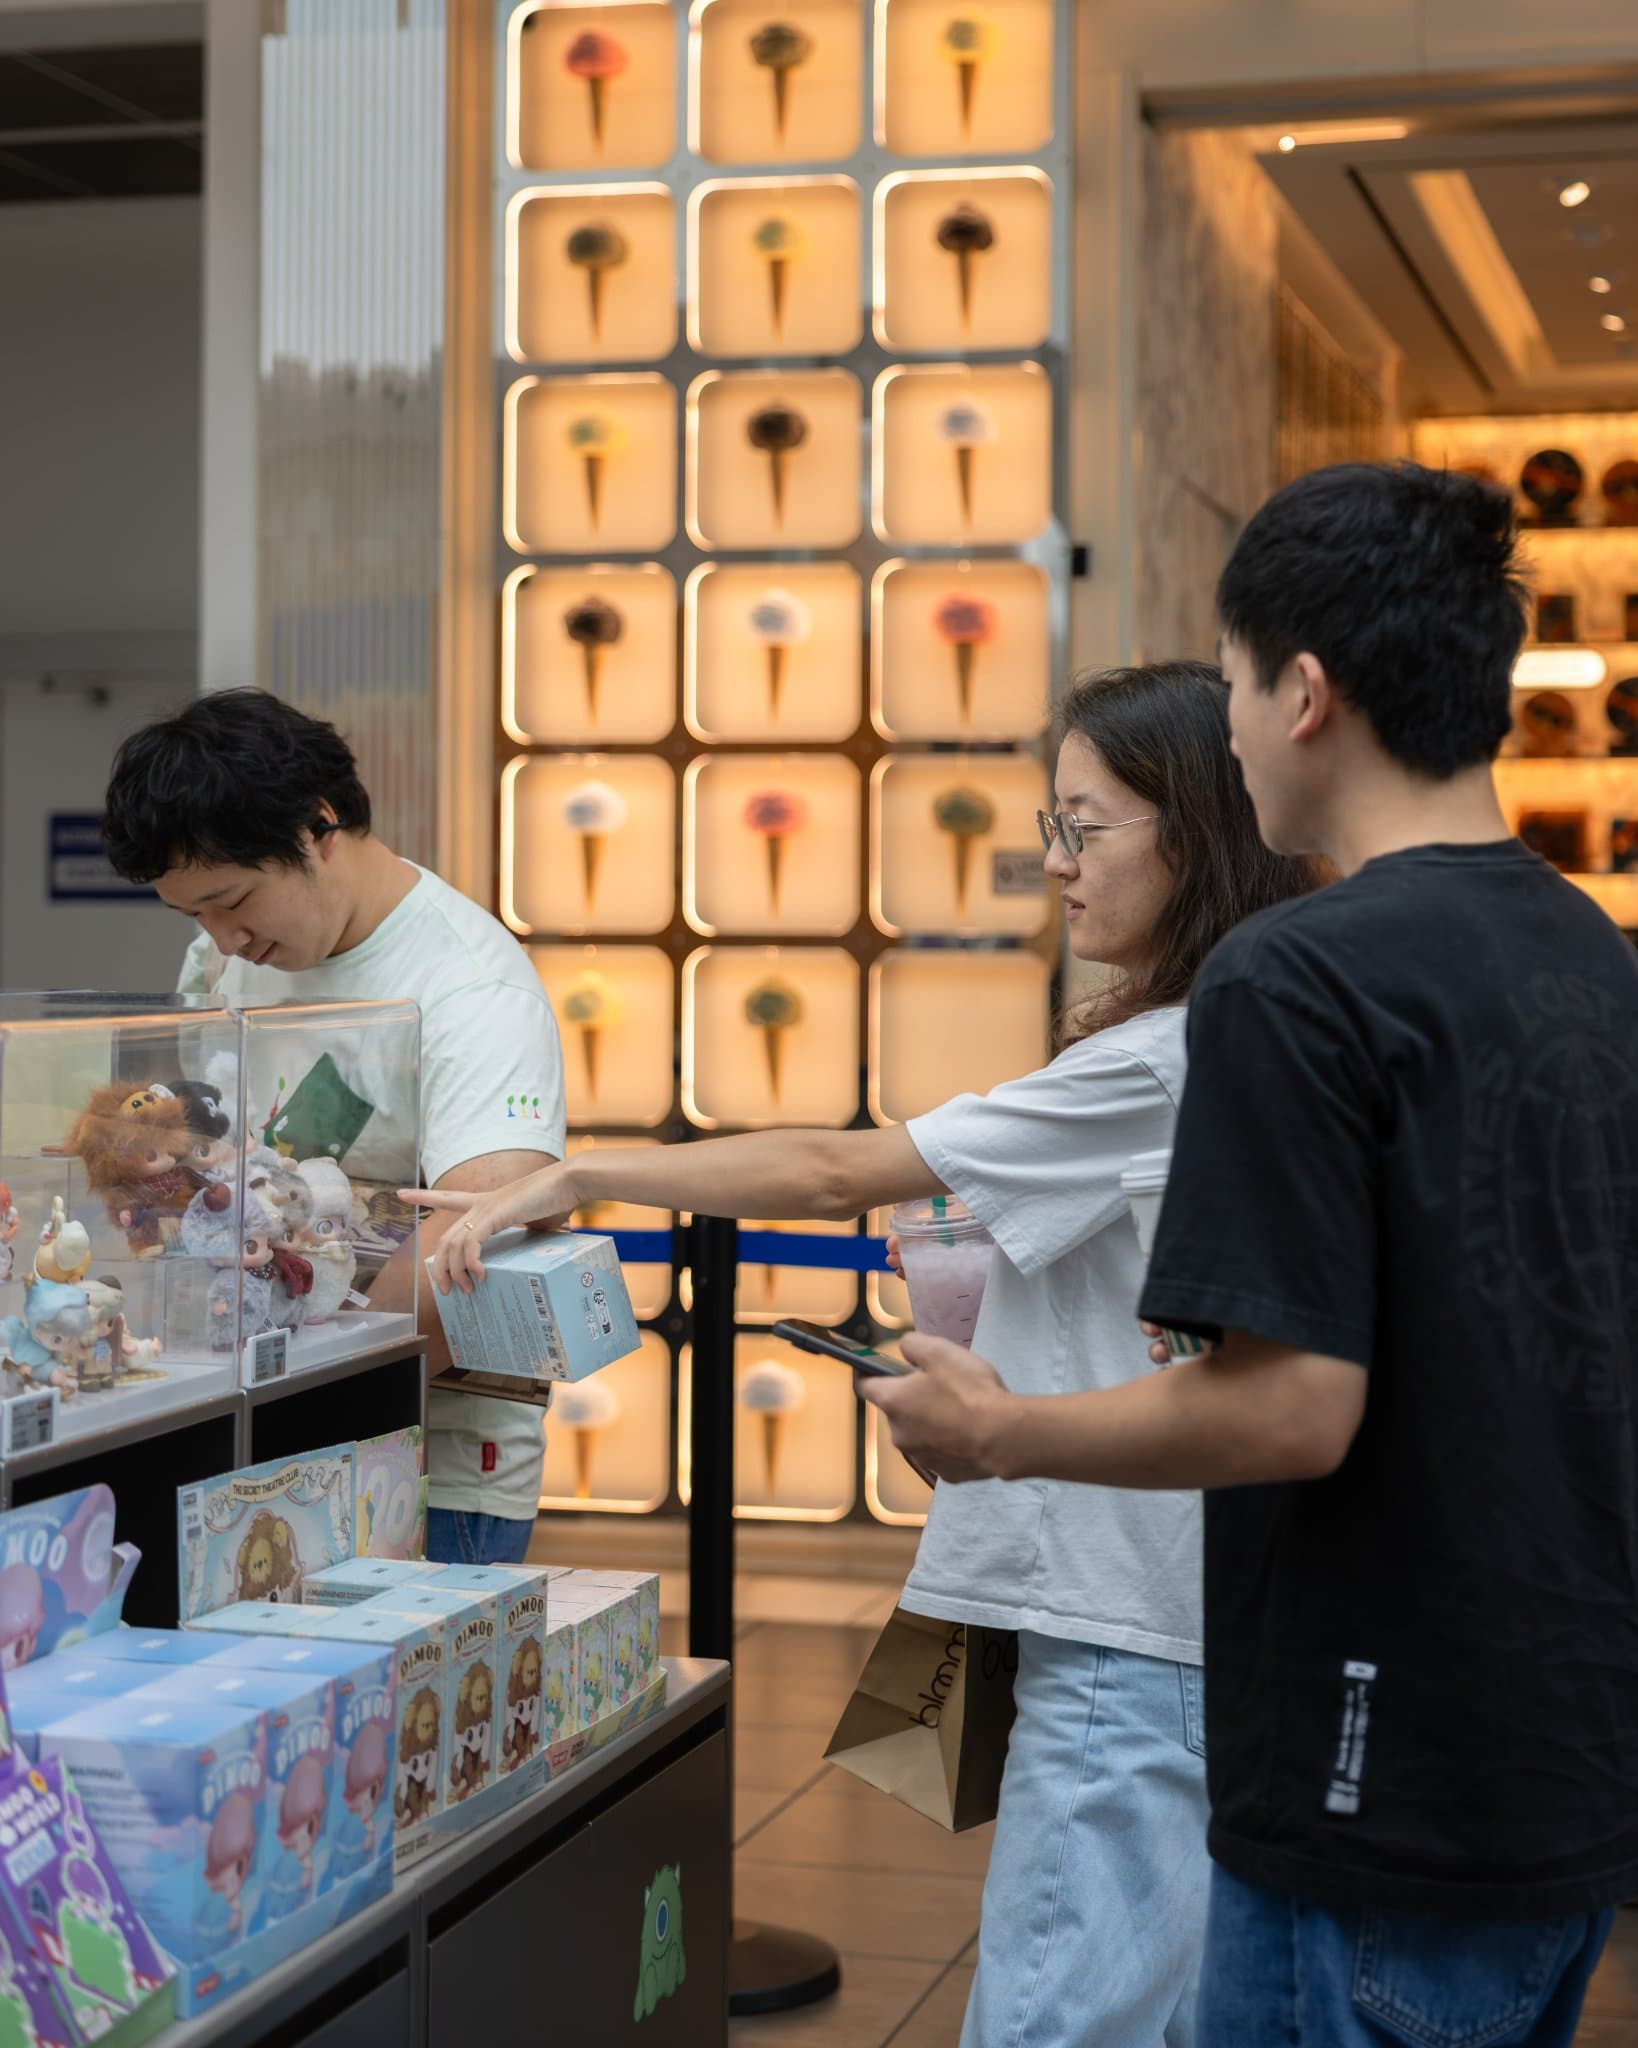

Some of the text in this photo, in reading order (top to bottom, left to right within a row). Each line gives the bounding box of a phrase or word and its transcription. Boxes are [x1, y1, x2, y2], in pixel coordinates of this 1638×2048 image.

[507, 1597, 544, 1626] DIMOO
[455, 1620, 494, 1651] DIMOO
[400, 1645, 442, 1678] DIMOO
